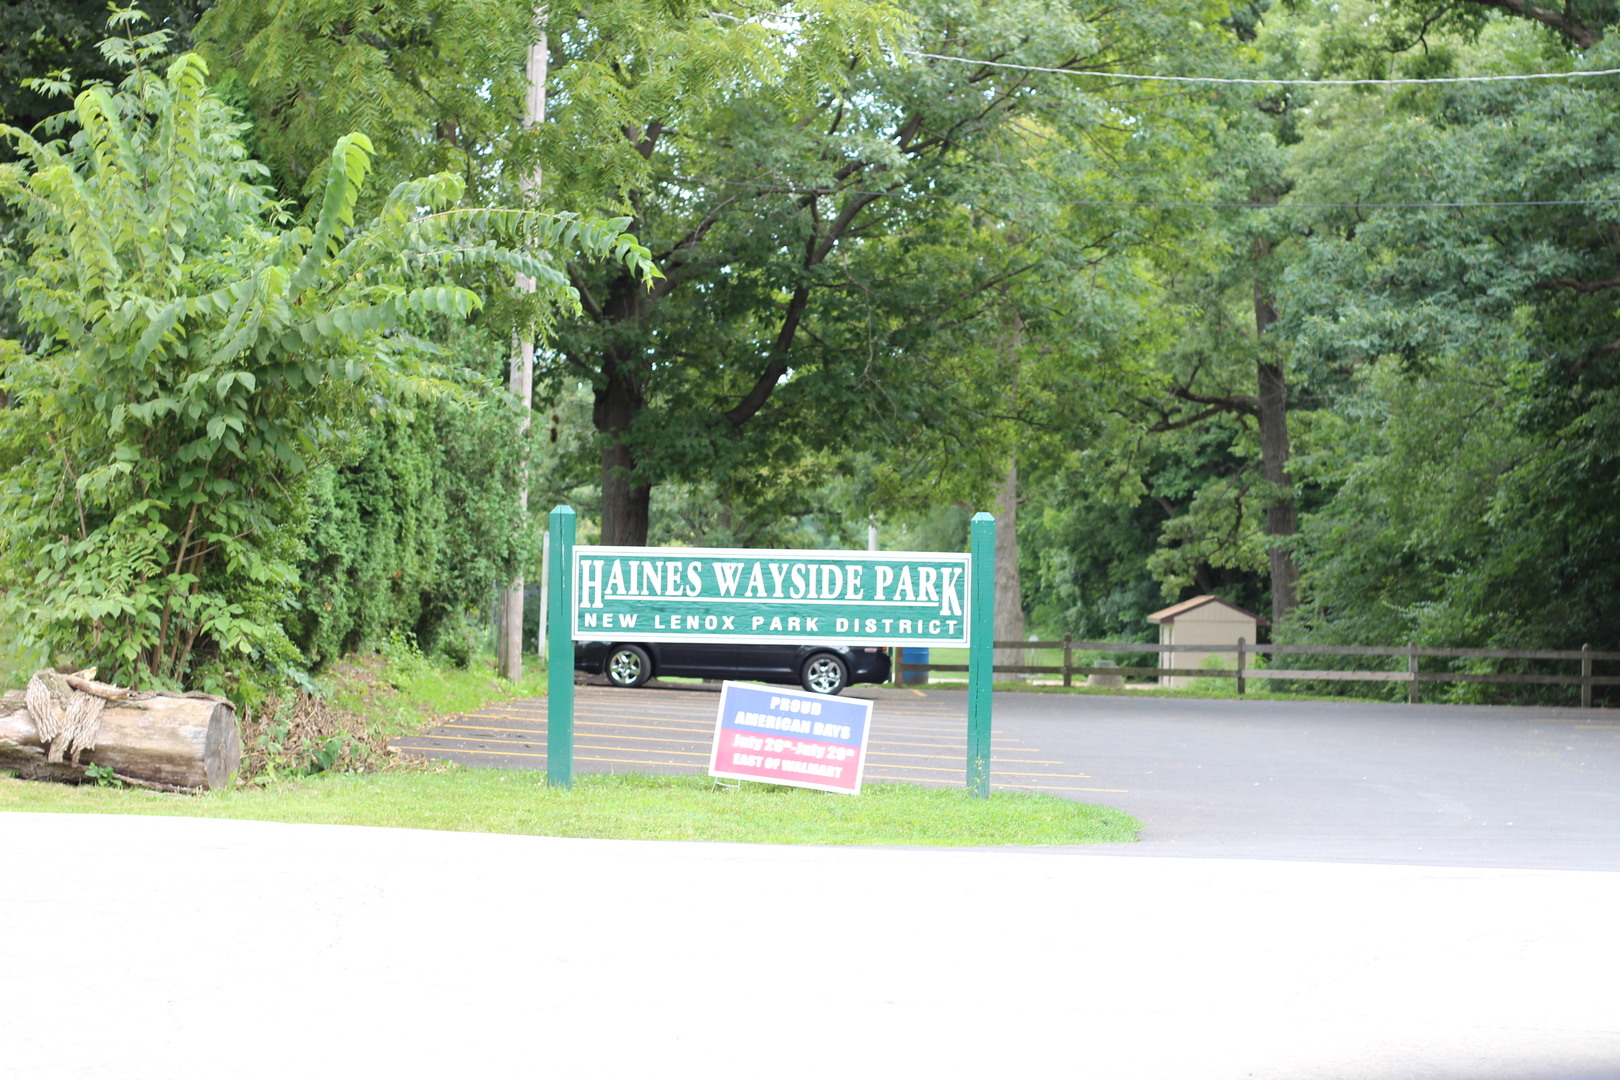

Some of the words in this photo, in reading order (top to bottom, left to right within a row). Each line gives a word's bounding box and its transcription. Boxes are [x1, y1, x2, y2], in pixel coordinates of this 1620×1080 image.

[580, 559, 702, 608] HAINES
[713, 561, 864, 600] WAYSIDE
[874, 565, 963, 616] PARK
[584, 613, 638, 628] NEW
[654, 614, 735, 631] LENOX
[751, 616, 819, 632] PARK
[835, 617, 958, 635] DISTRICT
[770, 696, 821, 715] PROUD
[734, 711, 811, 733] AMERICAN
[812, 722, 851, 740] DAYS
[732, 734, 763, 751] July
[733, 753, 763, 767] EAST
[764, 757, 781, 771] OF
[782, 760, 843, 778] WALMART
